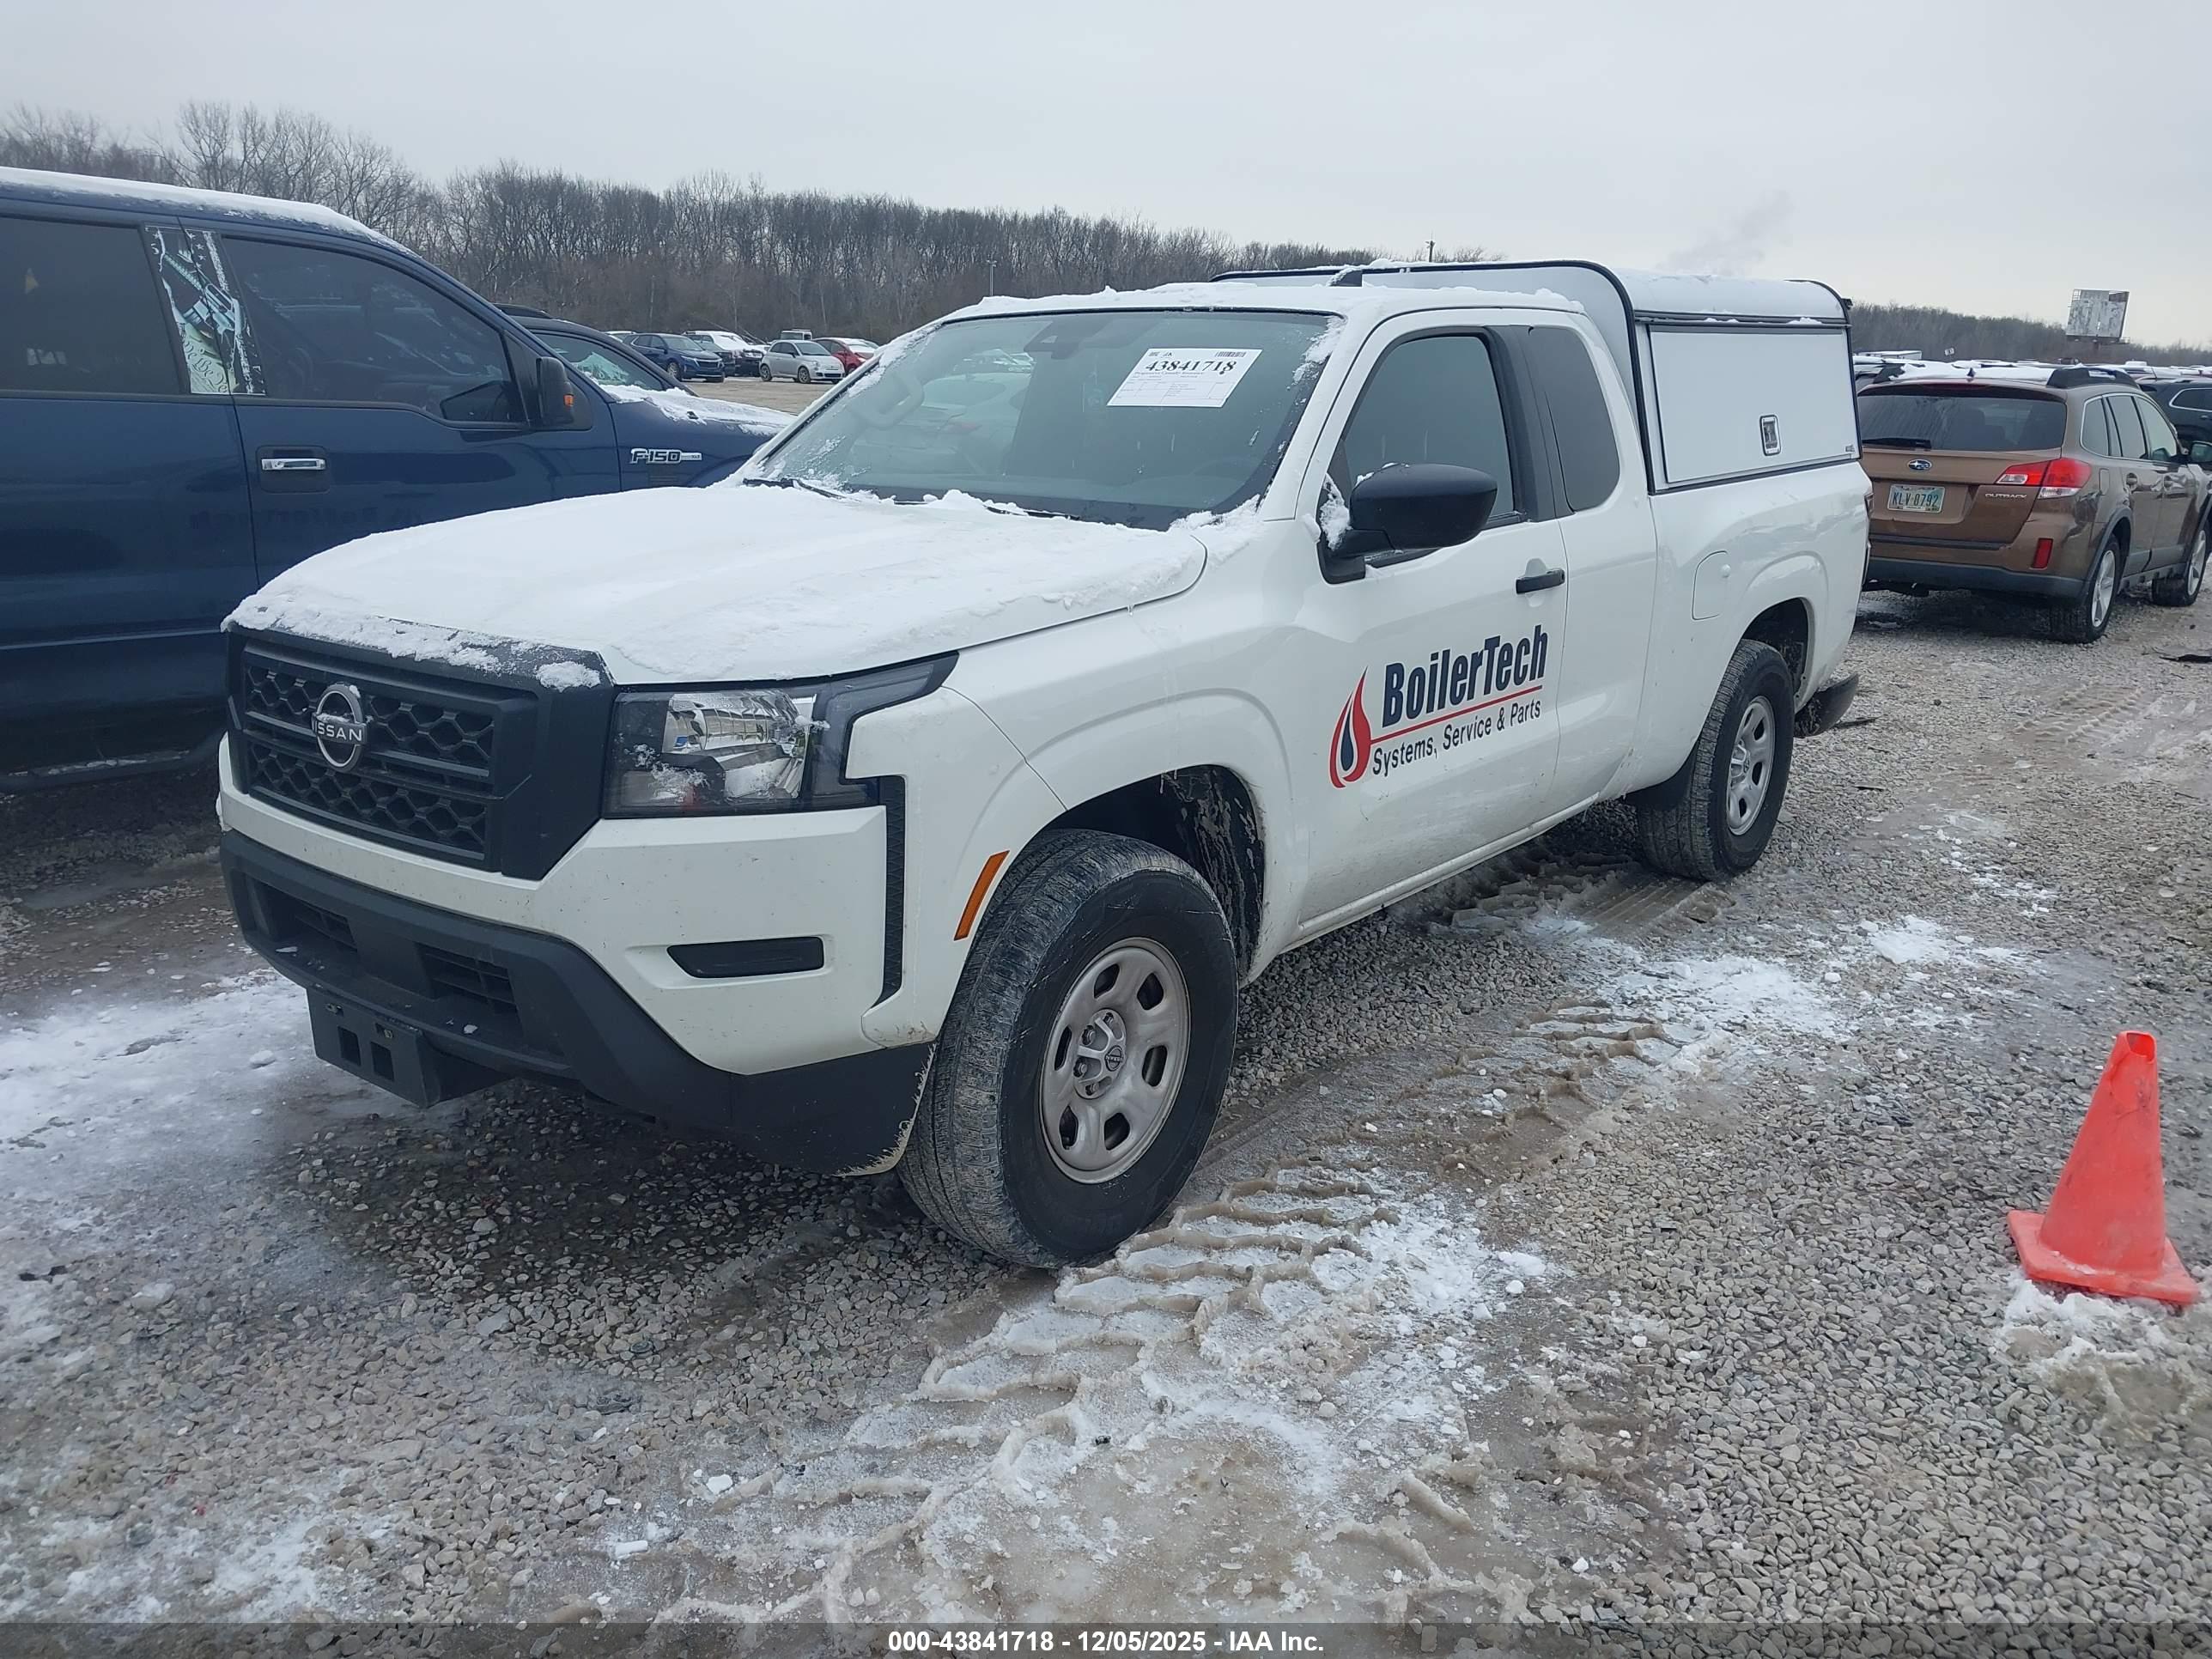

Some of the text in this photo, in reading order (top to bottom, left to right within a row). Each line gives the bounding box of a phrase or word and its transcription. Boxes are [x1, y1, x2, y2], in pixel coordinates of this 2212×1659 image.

[1146, 360, 1237, 372] 43841718
[630, 447, 682, 464] F-150
[1892, 492, 1939, 507] KLV 0792
[1382, 624, 1548, 728] BoilerTech
[311, 715, 362, 741] ISSAN
[1372, 699, 1540, 776] Systems, Service & Parts
